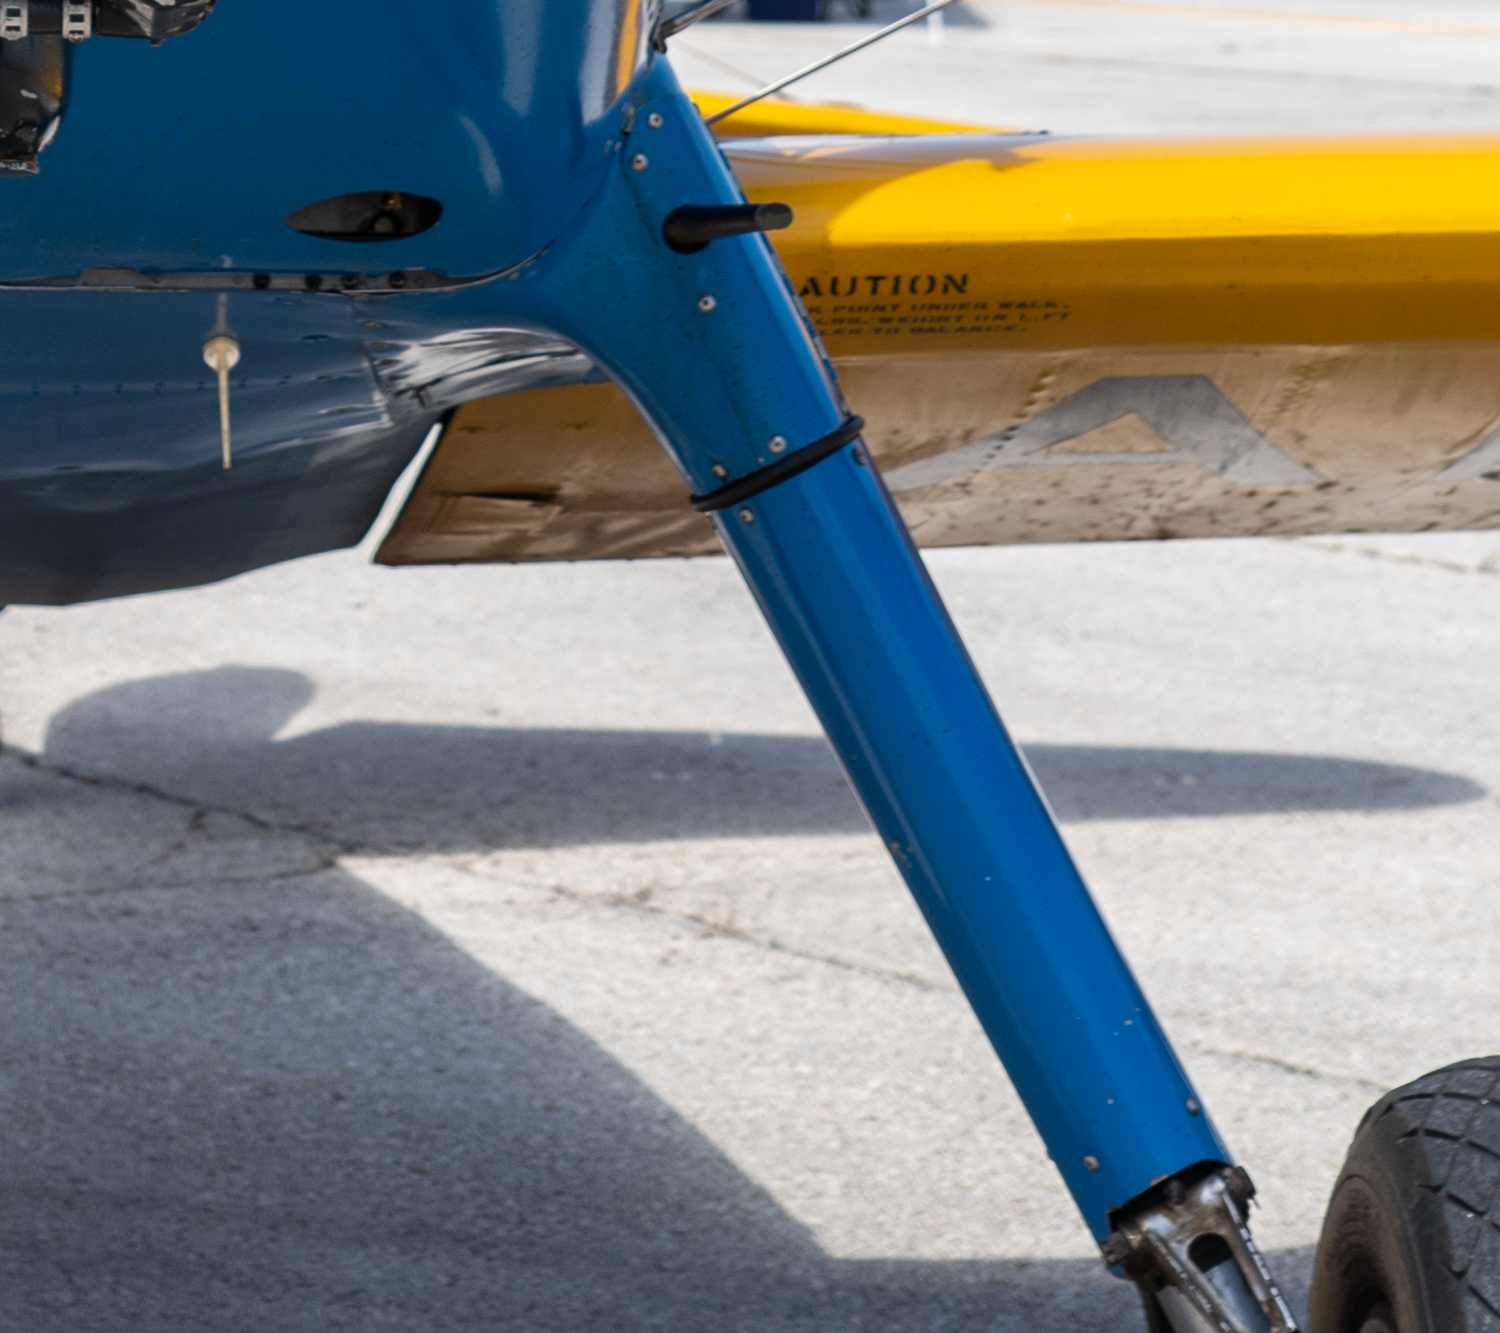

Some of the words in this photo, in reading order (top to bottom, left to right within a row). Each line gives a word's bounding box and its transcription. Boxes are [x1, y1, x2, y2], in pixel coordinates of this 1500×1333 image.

[801, 274, 969, 297] AUTION
[832, 302, 900, 313] POINT
[910, 301, 989, 312] UNDER
